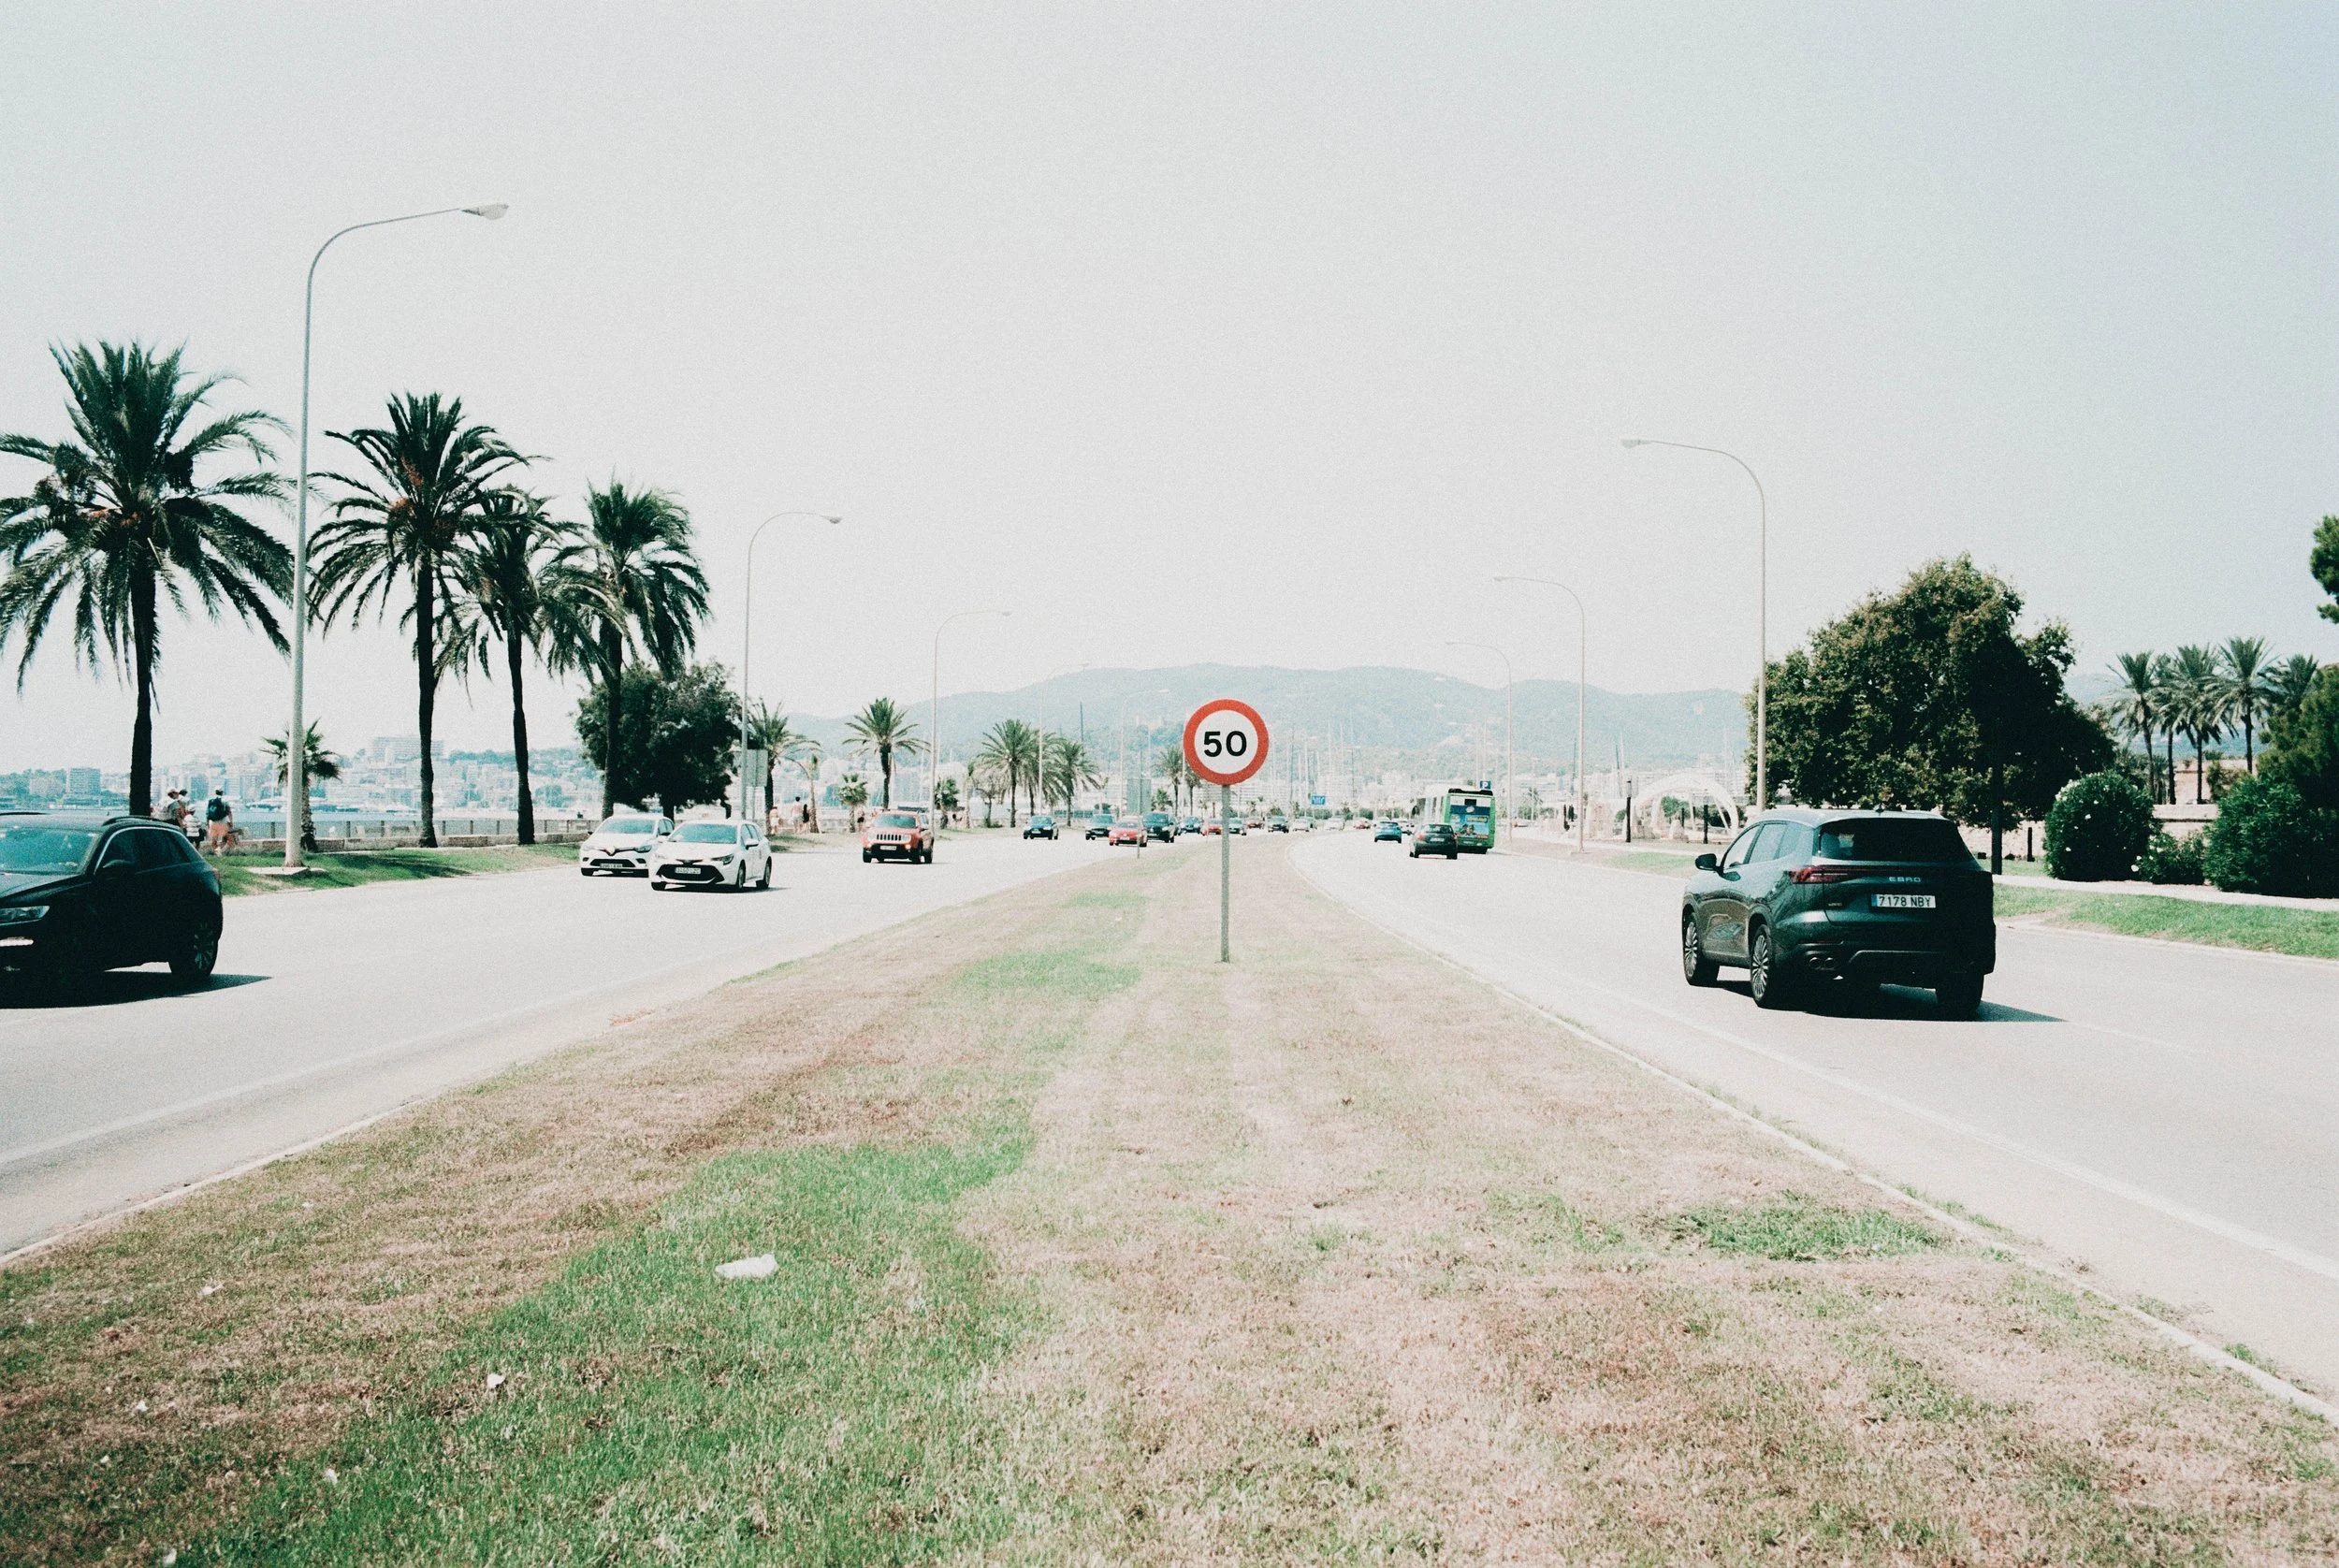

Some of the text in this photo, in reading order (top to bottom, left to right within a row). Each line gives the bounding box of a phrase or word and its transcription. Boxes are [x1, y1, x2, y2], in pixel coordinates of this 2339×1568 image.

[1203, 730, 1247, 757] 50
[1482, 781, 1489, 790] P
[1879, 895, 1931, 907] 7178 NBY
